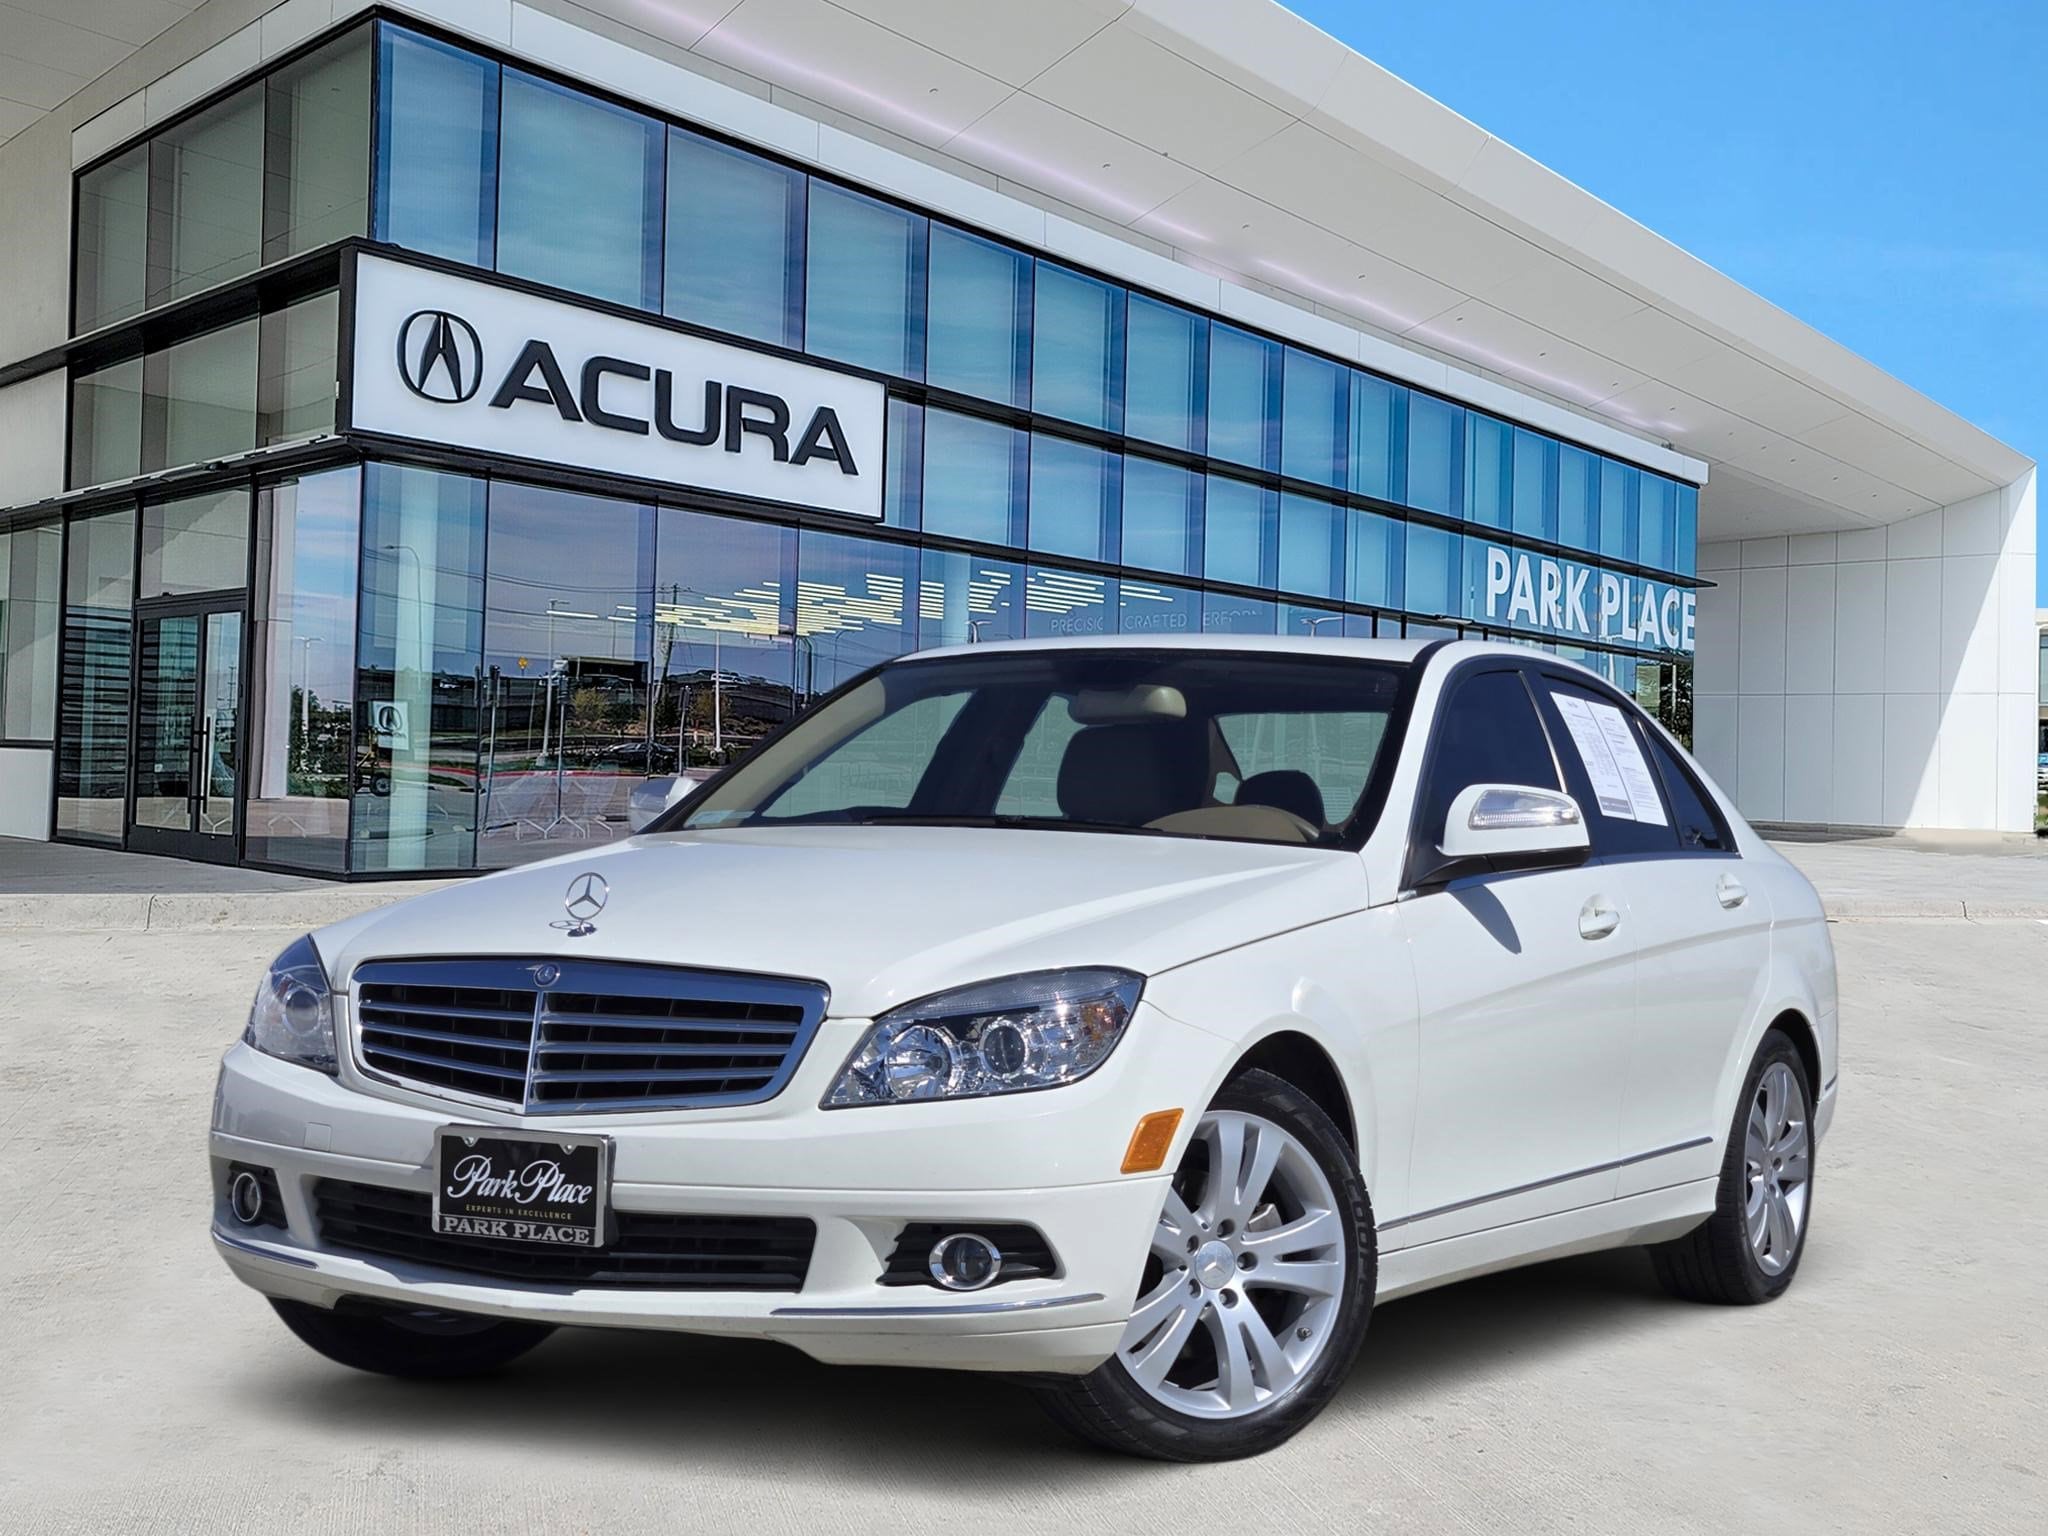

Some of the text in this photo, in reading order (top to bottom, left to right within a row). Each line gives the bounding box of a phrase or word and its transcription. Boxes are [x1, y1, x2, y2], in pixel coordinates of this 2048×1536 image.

[488, 340, 859, 477] ACURA
[1487, 546, 1697, 651] PARK PLACE
[1125, 613, 1188, 630] CRAFTED
[447, 1154, 592, 1204] Park Place
[444, 1216, 590, 1244] PARK PLACE
[465, 1204, 572, 1221] EXPERTS IN EXCELLENCE
